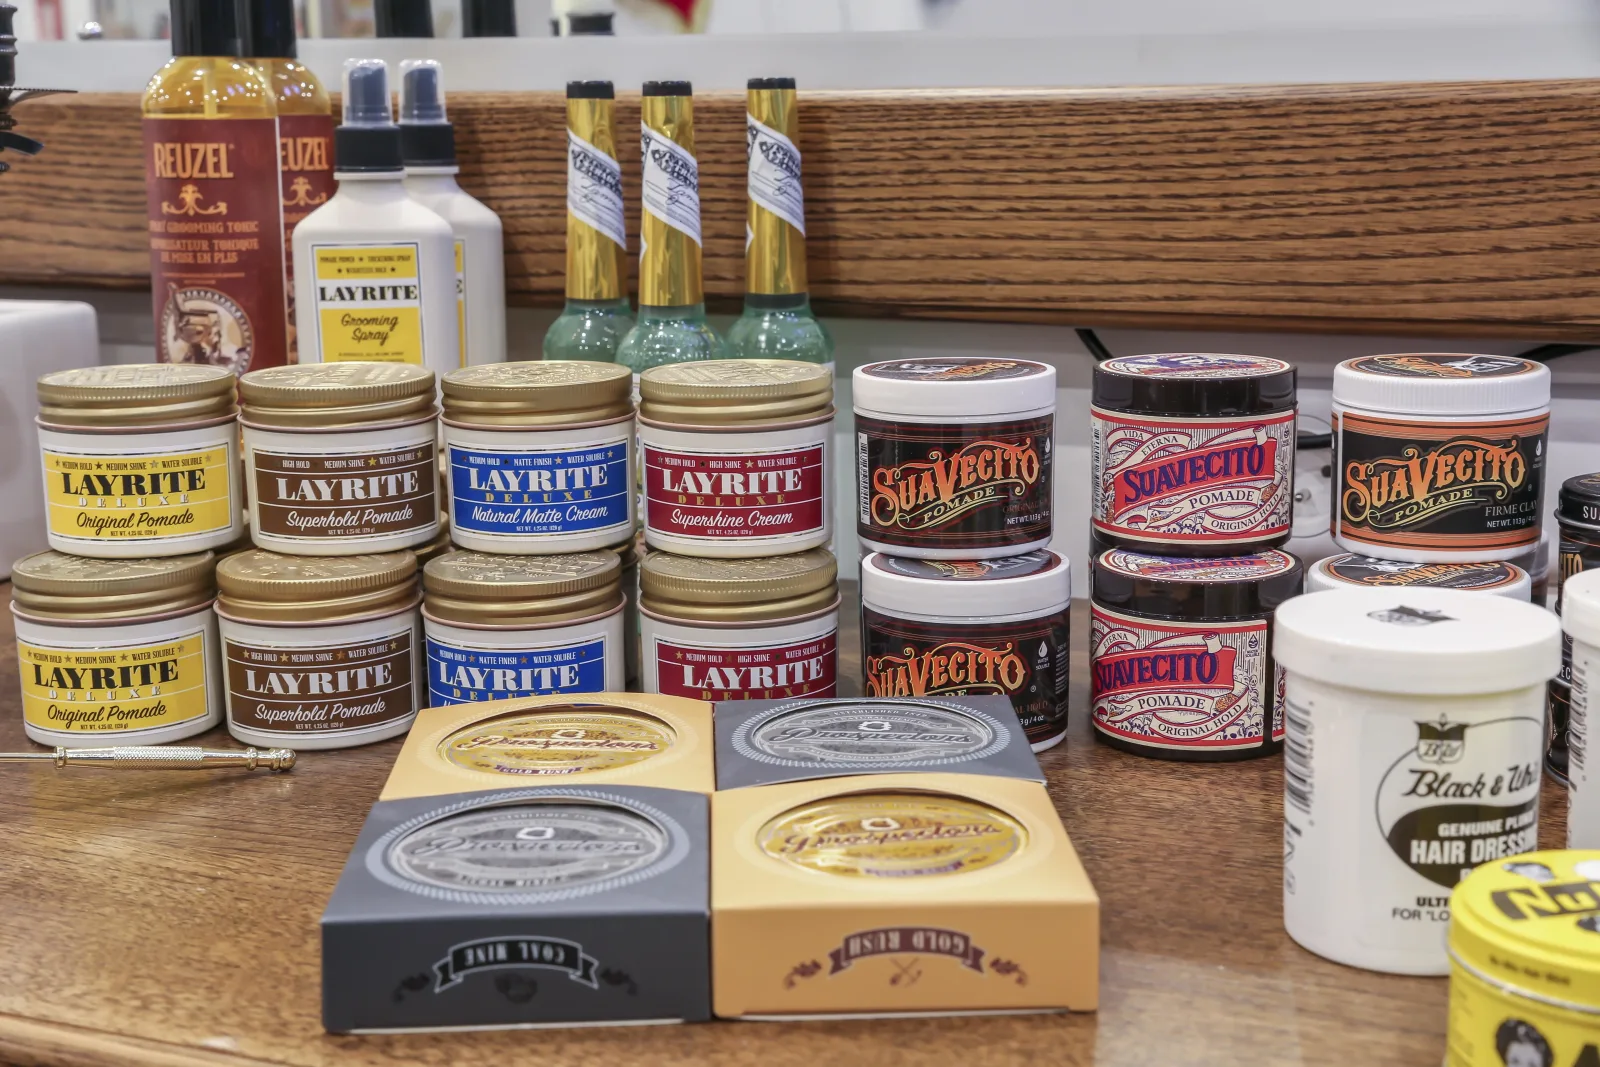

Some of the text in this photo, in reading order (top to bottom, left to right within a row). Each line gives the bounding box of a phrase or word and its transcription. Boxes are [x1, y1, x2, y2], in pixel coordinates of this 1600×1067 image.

[154, 142, 233, 179] REUZEL
[280, 136, 330, 171] EUZEL
[227, 221, 259, 233] TONIC
[319, 284, 418, 301] LAYRITE
[340, 313, 399, 332] Grooming
[351, 327, 389, 347] Spray
[1122, 430, 1145, 441] VIDA
[1140, 435, 1180, 457] ETERNA
[79, 462, 93, 471] HOLD
[105, 462, 129, 471] MEDIUM
[129, 461, 147, 471] SHINE
[161, 458, 180, 469] WATER
[181, 456, 203, 468] SOLUBLE
[282, 459, 294, 469] HIGH
[295, 460, 311, 469] HOLD
[324, 460, 347, 469] MEDIUM
[347, 458, 366, 468] SHINE
[378, 455, 396, 466] WATER
[513, 458, 533, 467] MATTE
[533, 457, 553, 466] FINISH
[566, 454, 585, 464] WATER
[585, 452, 606, 463] SOLUBLE
[682, 459, 696, 468] HOLD
[709, 460, 723, 469] HIGH
[724, 460, 742, 469] SHINE
[757, 459, 775, 468] WATER
[60, 468, 206, 497] LAYRITE
[468, 463, 609, 493] LAYRITE
[661, 467, 803, 496] LAYRITE
[870, 437, 1041, 527] SUAVECITO
[1123, 443, 1266, 503] SUAVECITO
[1342, 439, 1526, 522] SUAVECITO
[275, 470, 419, 502] LAYRITE
[484, 489, 593, 504] DELUXE
[78, 493, 190, 508] DELUXE
[677, 494, 786, 507] DELUXE
[922, 486, 995, 524] POMADE
[1188, 489, 1256, 510] POMADE
[1393, 487, 1474, 523] POMADE
[285, 504, 414, 532] Superhold Pomade
[471, 504, 609, 525] Natural Matte Cream
[670, 508, 793, 530] Supershine Cream
[1006, 517, 1019, 525] NET
[1210, 495, 1280, 531] ORIGINAL HOLD
[1484, 504, 1519, 518] FIRME
[1582, 505, 1600, 520] SU
[76, 507, 195, 537] Original Pomade
[1486, 517, 1512, 529] NET WT.
[1102, 632, 1129, 650] ETERNA
[75, 655, 97, 665] MEDIUM
[98, 655, 117, 664] SHINE
[131, 651, 152, 662] WATER
[152, 647, 176, 659] SOLUBLE
[250, 643, 389, 663] HIGH HOLD MEDIUM SHINE WATER SOLUBLE
[478, 655, 498, 665] MATTE
[498, 656, 518, 665] FINISH
[532, 654, 553, 665] WATER
[553, 651, 577, 663] SOLUBLE
[685, 652, 706, 663] MEDIUM
[707, 654, 723, 664] HOLD
[737, 654, 752, 664] HIGH
[753, 653, 771, 663] SHINE
[785, 649, 802, 660] WATER
[32, 658, 179, 690] LAYRITE
[244, 661, 393, 696] LAYRITE
[438, 661, 580, 692] LAYRITE
[681, 656, 824, 691] LAYRITE
[1095, 650, 1218, 693] SUAVECITO
[48, 685, 161, 702] DELUXE
[700, 683, 811, 702] DELUXE
[1137, 696, 1206, 710] POMADE
[47, 700, 167, 730] Original Pomade
[254, 696, 387, 725] Superhold Pomade
[1158, 703, 1243, 737] ORIGINAL HOLD
[456, 734, 660, 752] Prospectors
[771, 727, 972, 744] Prospectors
[502, 766, 534, 774] GOLD
[1402, 768, 1486, 799] Black
[1489, 774, 1504, 797] &
[1437, 818, 1504, 838] GENUINE
[1410, 839, 1466, 865] HAIR
[1392, 907, 1422, 921] FOR
[517, 941, 566, 966] COAL
[848, 930, 966, 957] GOLD RUSH
